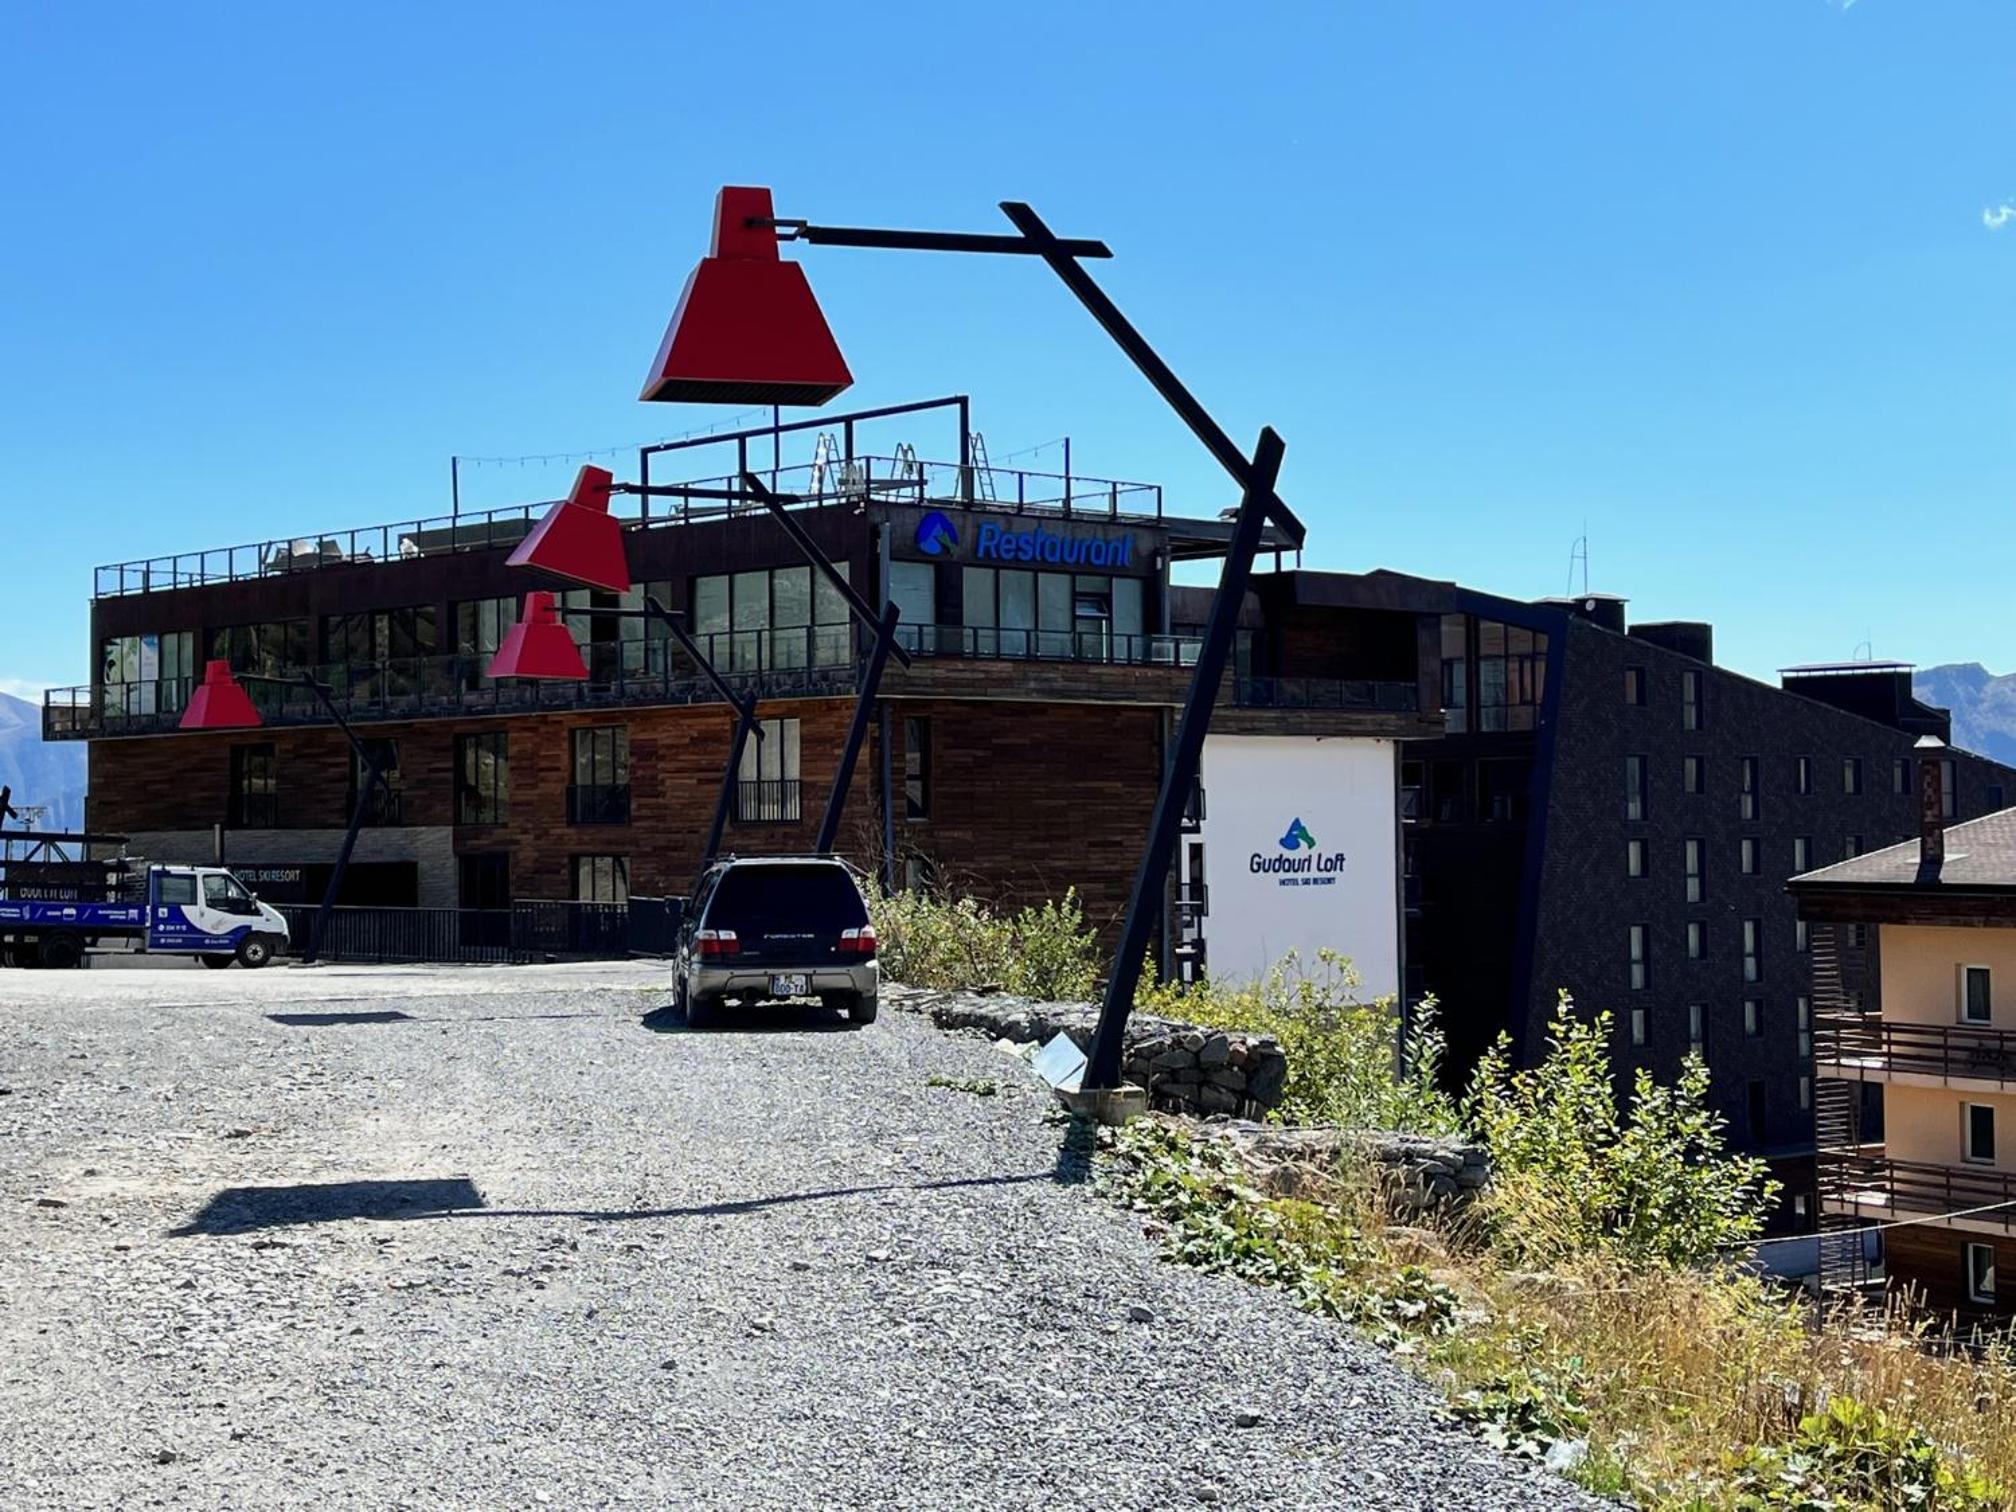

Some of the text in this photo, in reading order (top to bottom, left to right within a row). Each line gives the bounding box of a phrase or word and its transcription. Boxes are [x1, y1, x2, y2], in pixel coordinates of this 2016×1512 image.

[977, 520, 1136, 567] Restaurant
[1250, 853, 1346, 873] Gudauri Loft
